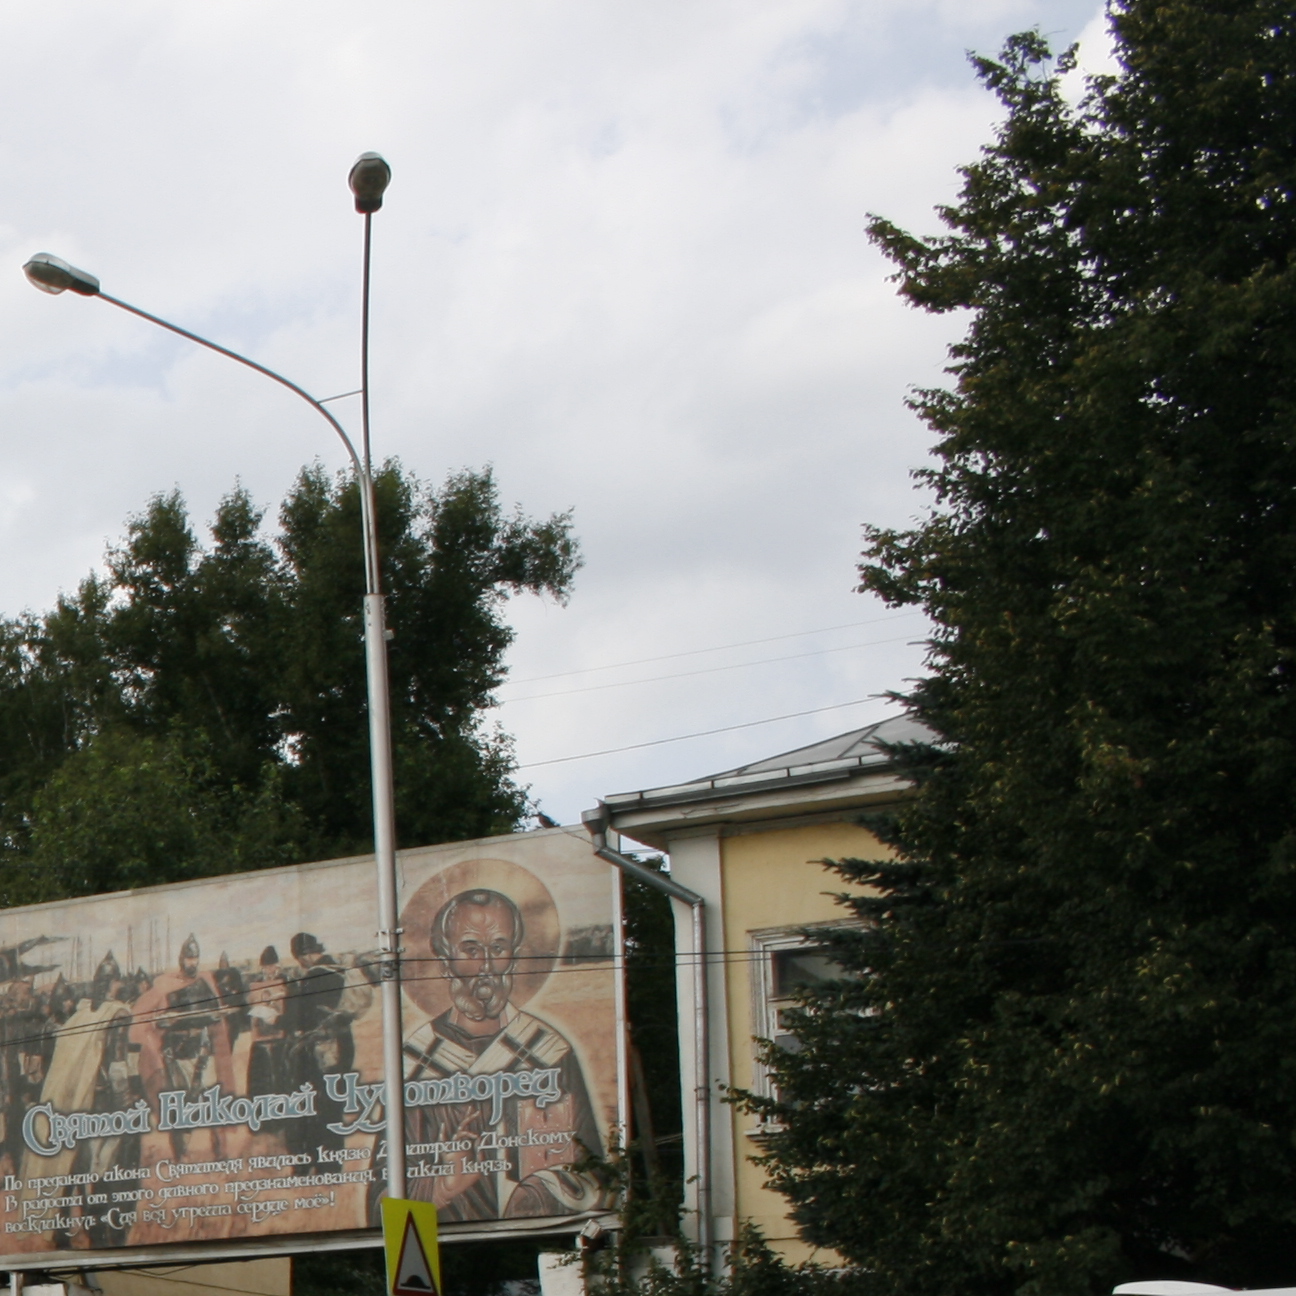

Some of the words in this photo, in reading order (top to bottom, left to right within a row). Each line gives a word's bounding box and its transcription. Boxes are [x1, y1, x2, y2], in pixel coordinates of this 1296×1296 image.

[22, 1099, 151, 1156] Святой
[158, 1082, 317, 1131] Николай
[4, 1175, 23, 1192] По
[28, 1171, 99, 1197] преданию
[103, 1165, 151, 1182] икона
[155, 1158, 243, 1183] Святителя
[248, 1153, 312, 1173] явилась
[316, 1145, 371, 1164] князю
[477, 1129, 577, 1154] Донскому
[5, 1195, 18, 1213] В
[22, 1193, 83, 1220] радости
[87, 1193, 108, 1205] от
[111, 1188, 154, 1204] этого
[149, 1181, 219, 1208] дивного
[225, 1170, 376, 1201] предзнаменования,
[461, 1155, 512, 1174] князь
[5, 1213, 96, 1237] воскликнул:
[100, 1207, 137, 1230] «Сия
[143, 1207, 166, 1223] вся
[237, 1199, 288, 1223] сердце
